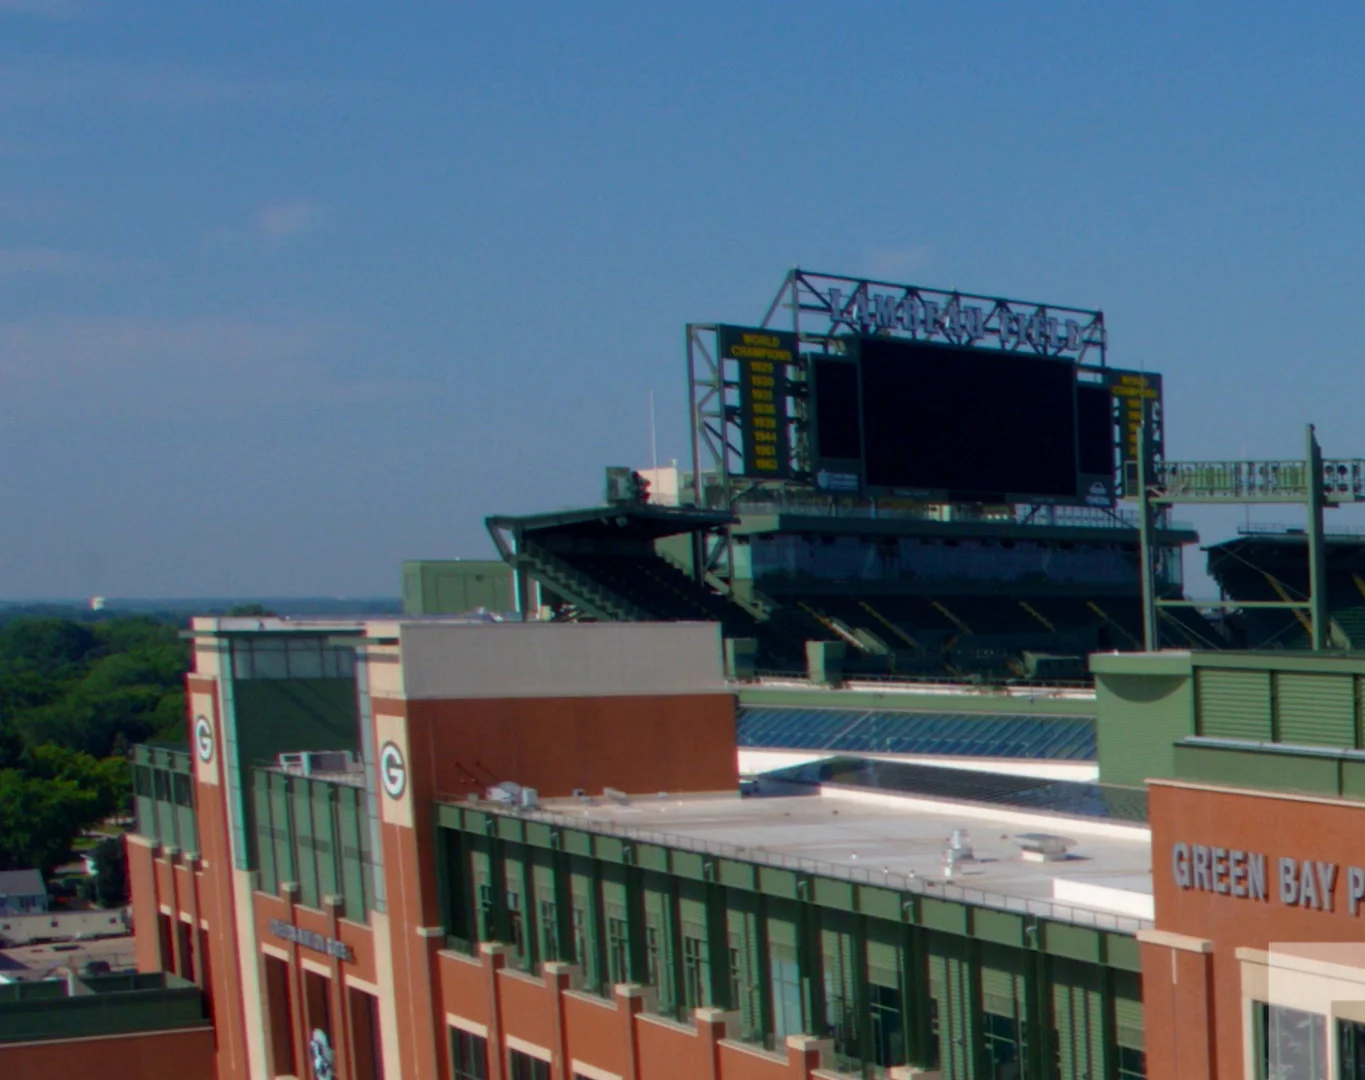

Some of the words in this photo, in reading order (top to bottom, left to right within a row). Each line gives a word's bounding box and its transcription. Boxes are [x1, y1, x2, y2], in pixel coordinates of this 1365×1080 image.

[828, 288, 984, 339] LAMBEAU
[1000, 312, 1083, 350] FIELD
[1172, 842, 1267, 901] GREEN
[1278, 856, 1339, 912] BAY
